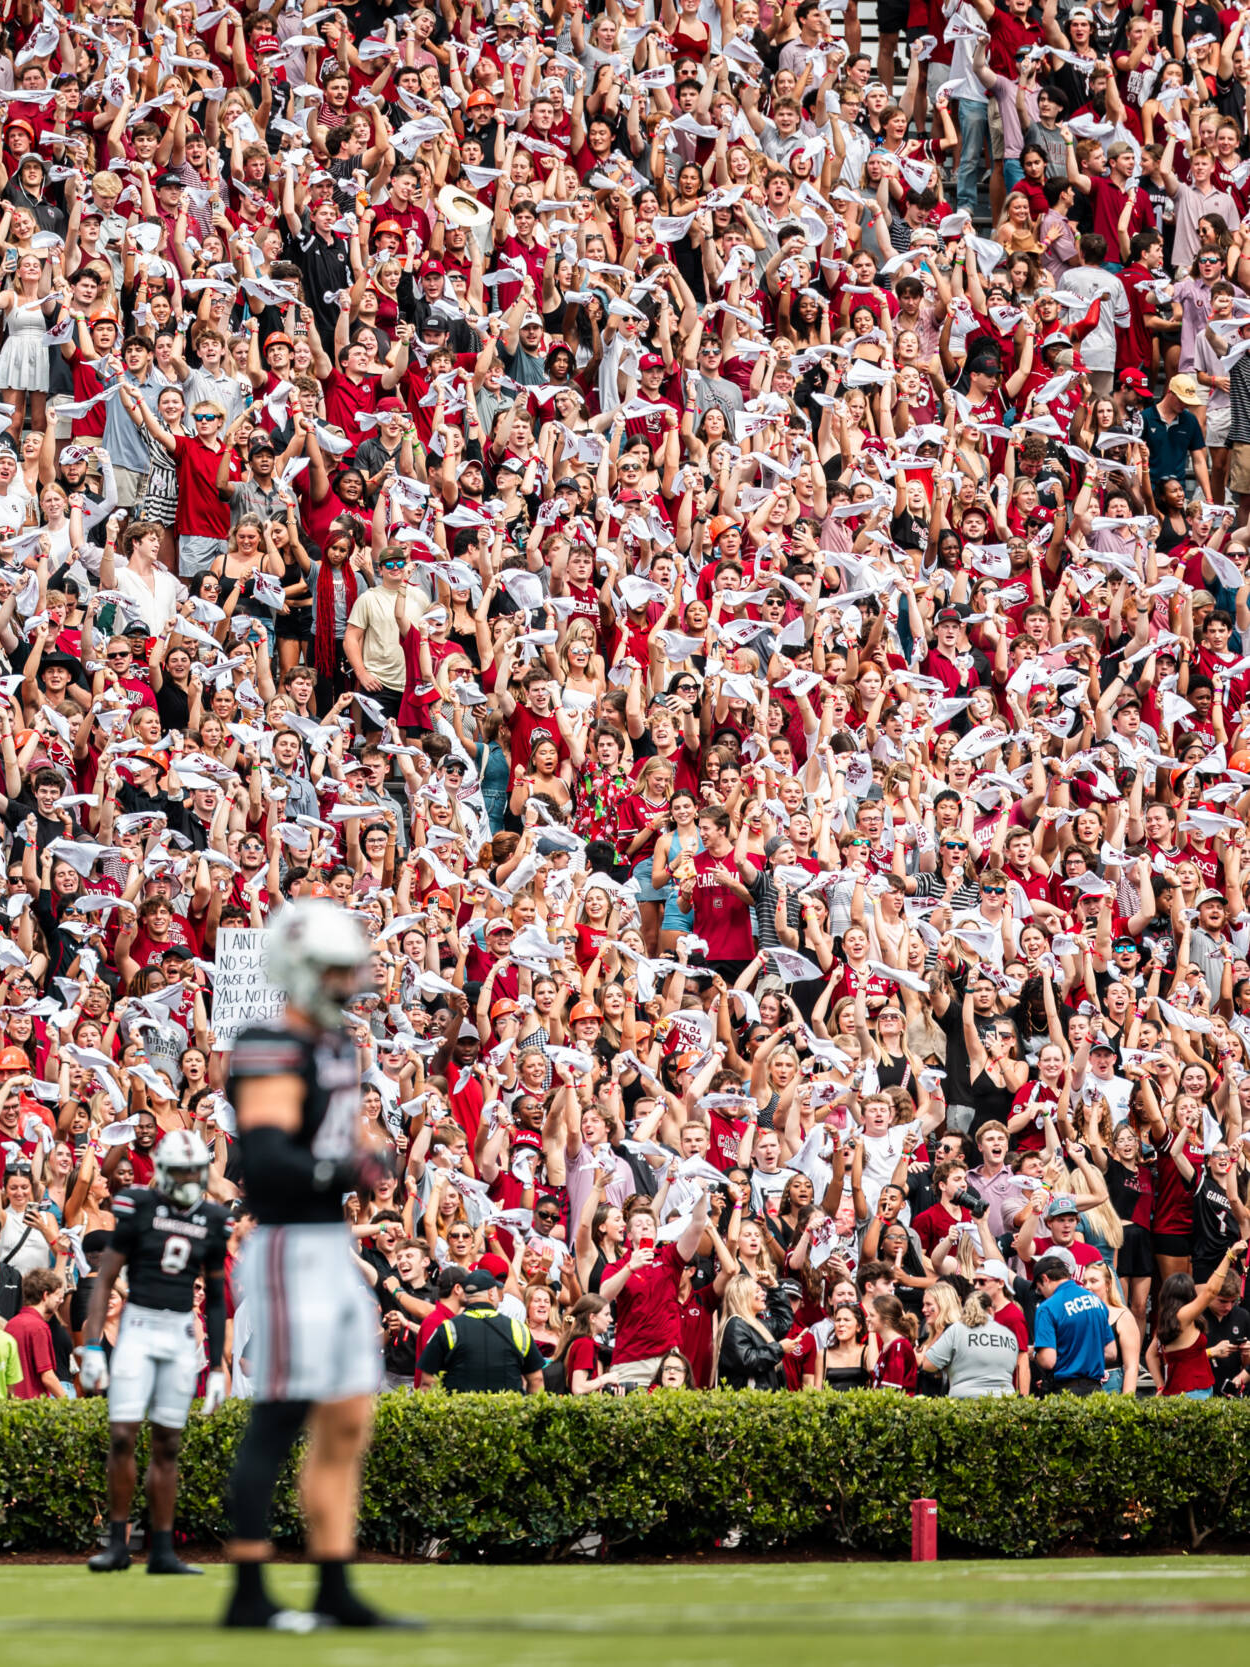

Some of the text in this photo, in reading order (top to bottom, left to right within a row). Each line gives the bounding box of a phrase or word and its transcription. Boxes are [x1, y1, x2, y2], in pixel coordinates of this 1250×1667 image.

[697, 872, 740, 888] CARNA
[220, 955, 268, 971] NO SLE
[216, 973, 260, 986] CAUSE OF
[245, 989, 266, 1003] NOT
[214, 1006, 285, 1023] GET NO SLEE
[160, 1235, 191, 1274] 8
[968, 1333, 1016, 1352] RCEMS
